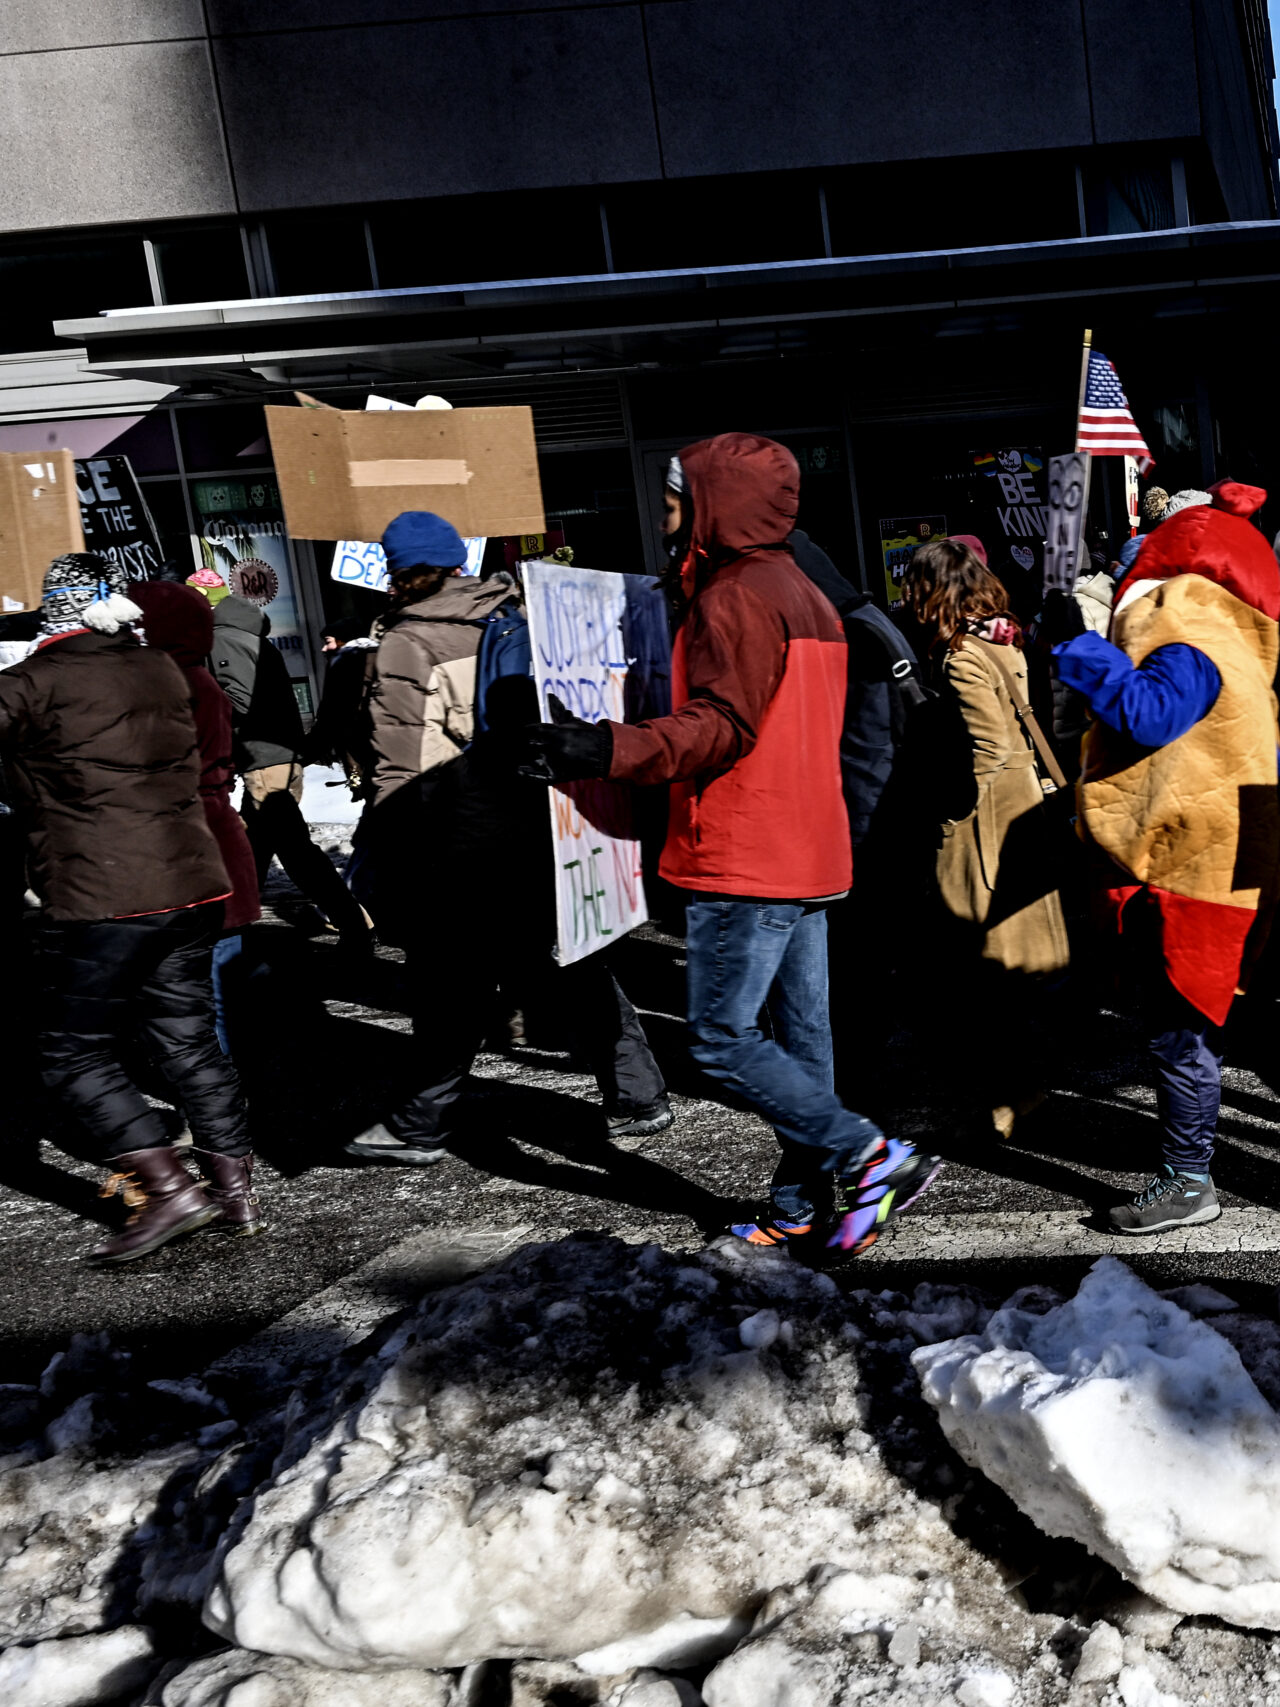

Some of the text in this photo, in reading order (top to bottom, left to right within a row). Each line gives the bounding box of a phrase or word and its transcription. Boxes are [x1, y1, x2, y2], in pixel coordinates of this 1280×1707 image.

[997, 472, 1041, 504] BE
[96, 504, 137, 534] THE
[563, 846, 613, 946] THE
